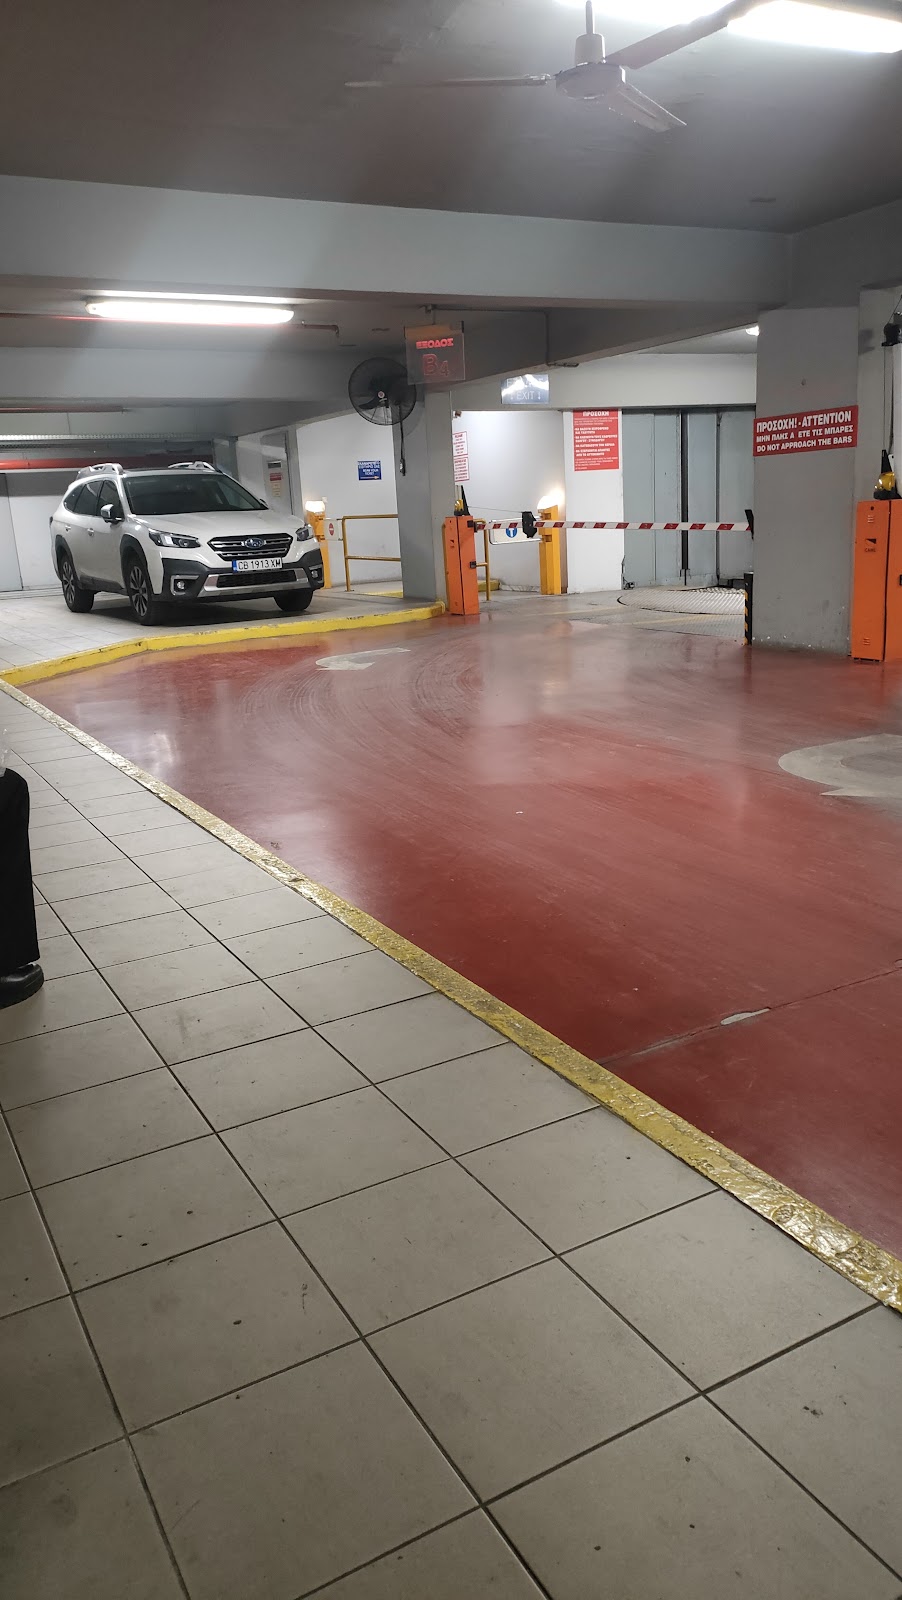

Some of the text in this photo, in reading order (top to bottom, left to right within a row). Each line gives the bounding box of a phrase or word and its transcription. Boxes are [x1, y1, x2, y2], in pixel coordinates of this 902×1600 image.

[416, 338, 454, 349] ΕΞΟΔΟΣ
[516, 390, 535, 400] EXIT
[757, 418, 797, 433] ΠΡΟΣΟΧΗ!
[802, 411, 851, 427] ATTENTION
[756, 434, 770, 443] ΜΗΝ
[812, 428, 823, 436] ΤΙΣ
[824, 425, 853, 435] ΜΠΑΡΕΣ
[756, 435, 852, 453] DO NOT APPROACH THE BARS
[238, 559, 281, 570] CB 1913 XM
